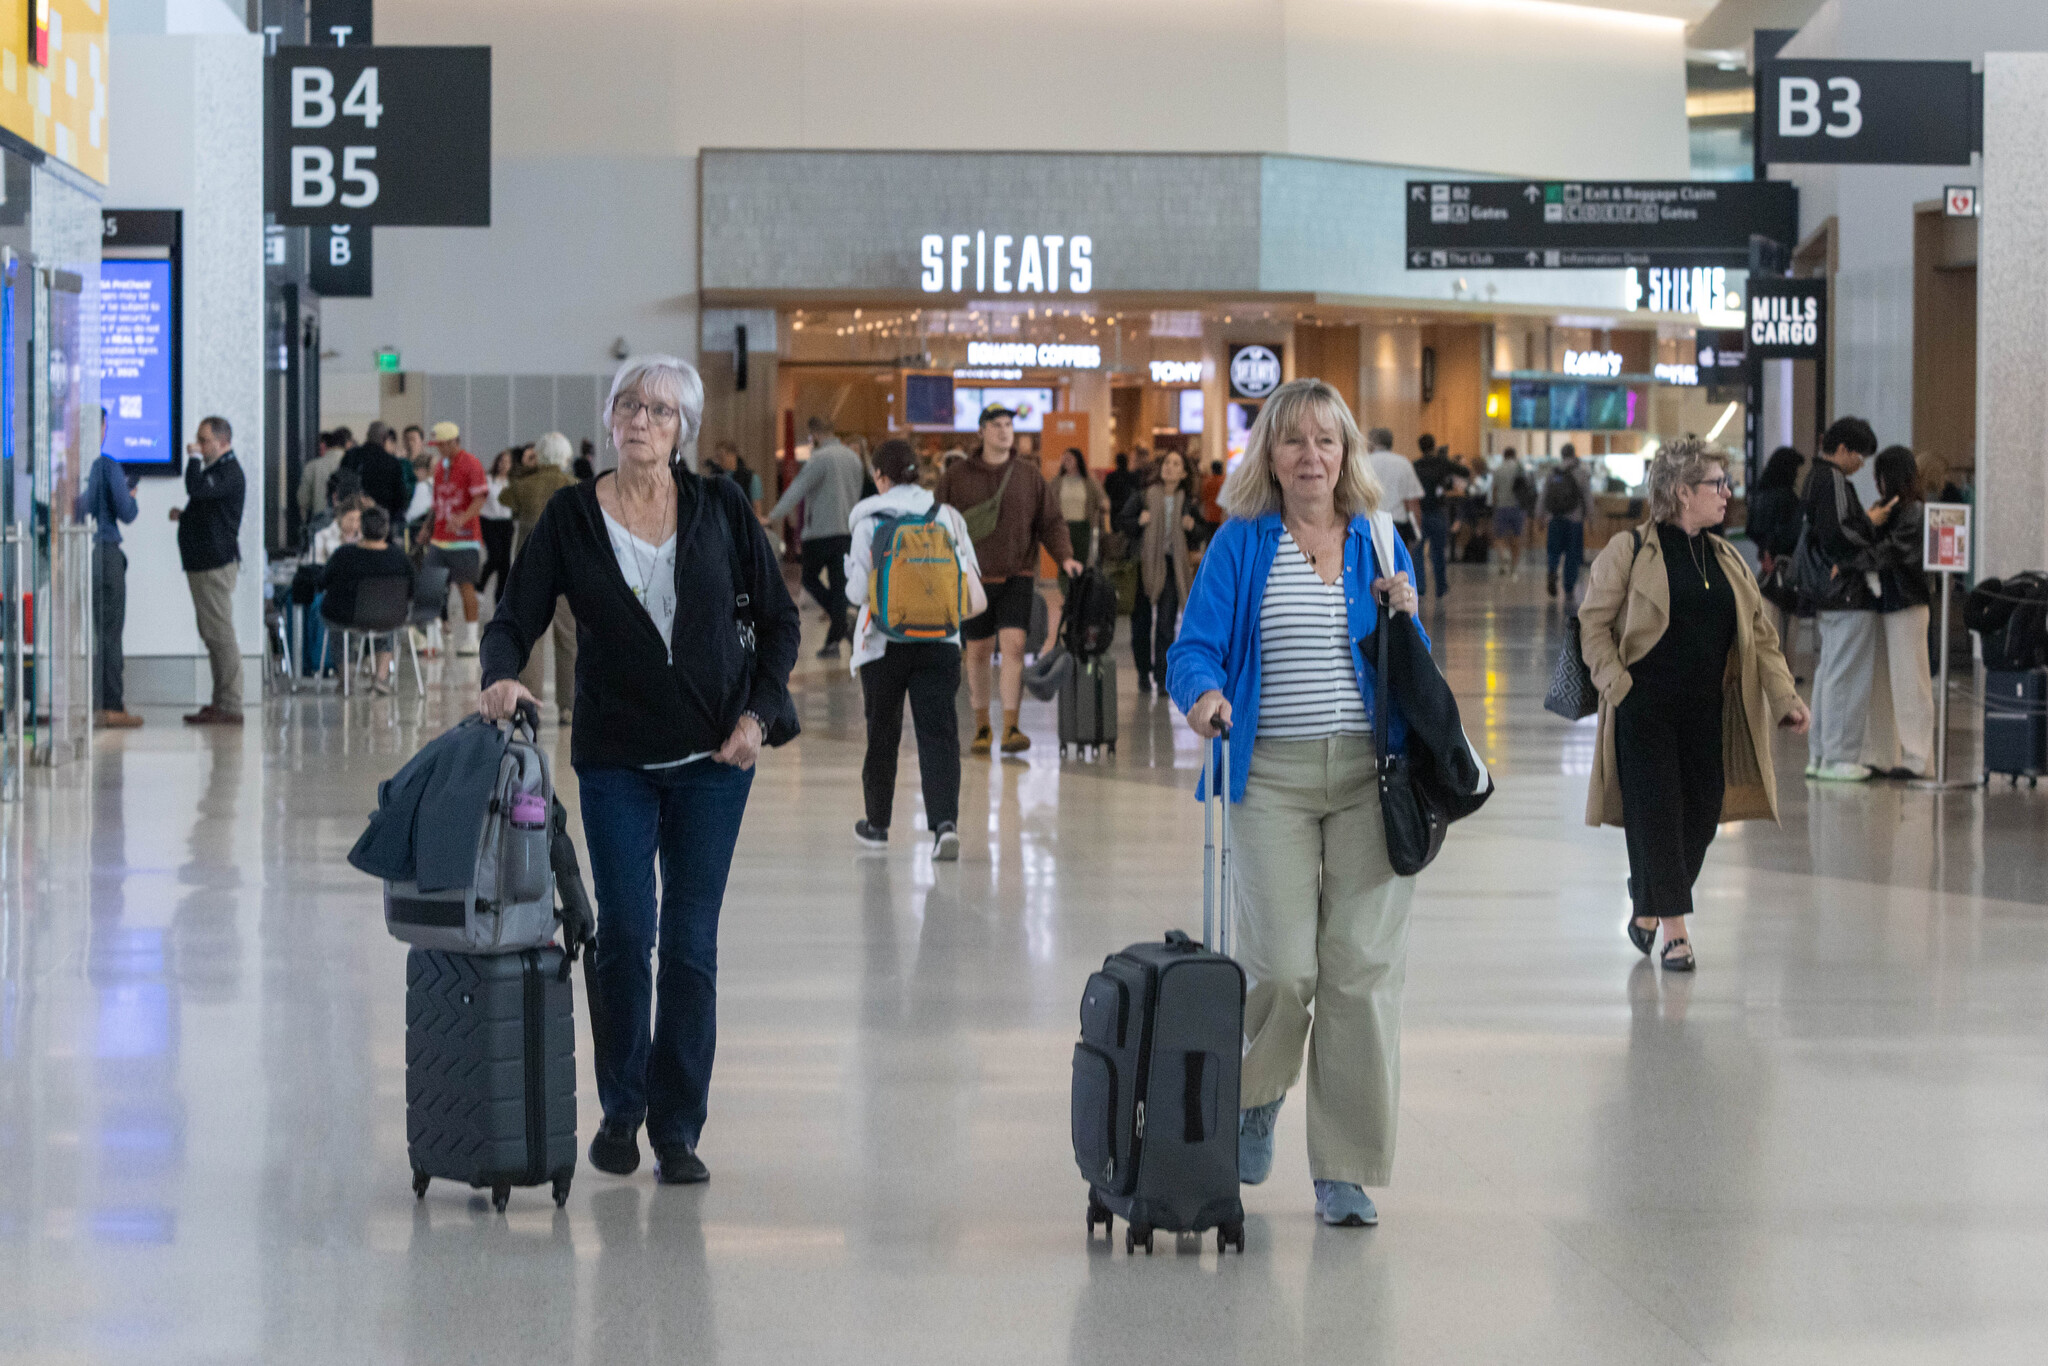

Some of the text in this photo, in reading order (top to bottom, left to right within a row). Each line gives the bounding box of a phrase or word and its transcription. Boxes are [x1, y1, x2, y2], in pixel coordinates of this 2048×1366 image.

[291, 67, 383, 128] B4
[1778, 77, 1862, 138] B3
[291, 146, 380, 208] B5
[1623, 186, 1679, 203] Baggage
[1471, 205, 1509, 220] Gates
[1660, 205, 1698, 220] Gates
[330, 236, 351, 266] B
[1752, 296, 1817, 323] MILLS
[1751, 322, 1817, 345] CARGO
